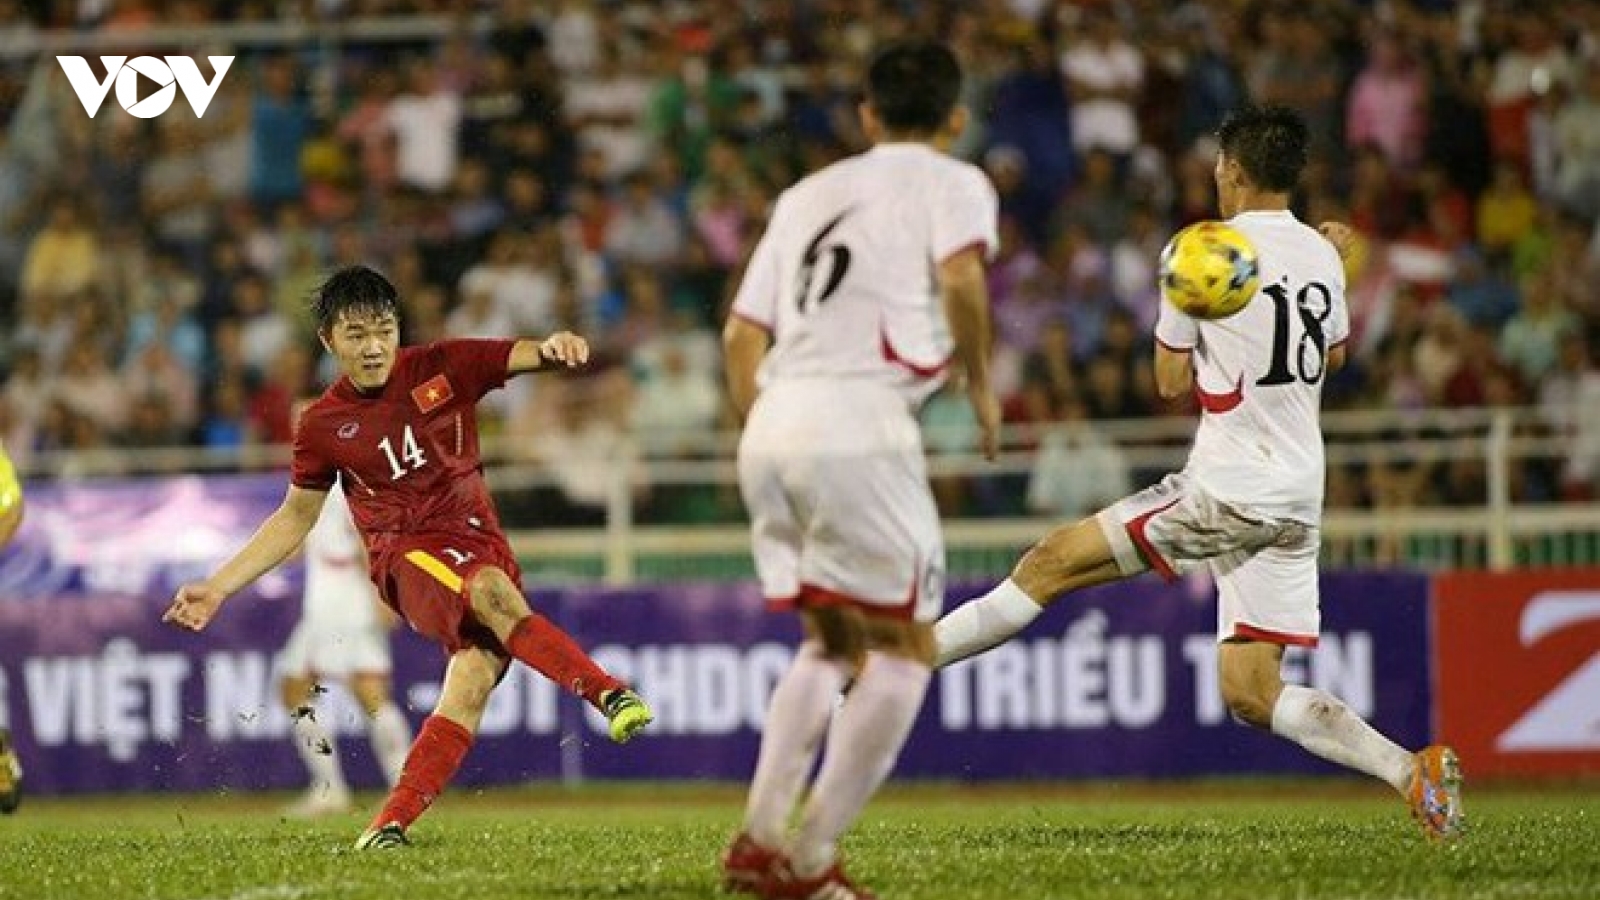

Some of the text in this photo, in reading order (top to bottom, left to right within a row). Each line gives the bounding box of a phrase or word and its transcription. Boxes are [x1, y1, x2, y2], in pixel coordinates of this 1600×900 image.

[797, 206, 851, 314] 6
[1256, 282, 1332, 386] 18
[378, 425, 427, 480] 14
[24, 642, 190, 762] VIỆT
